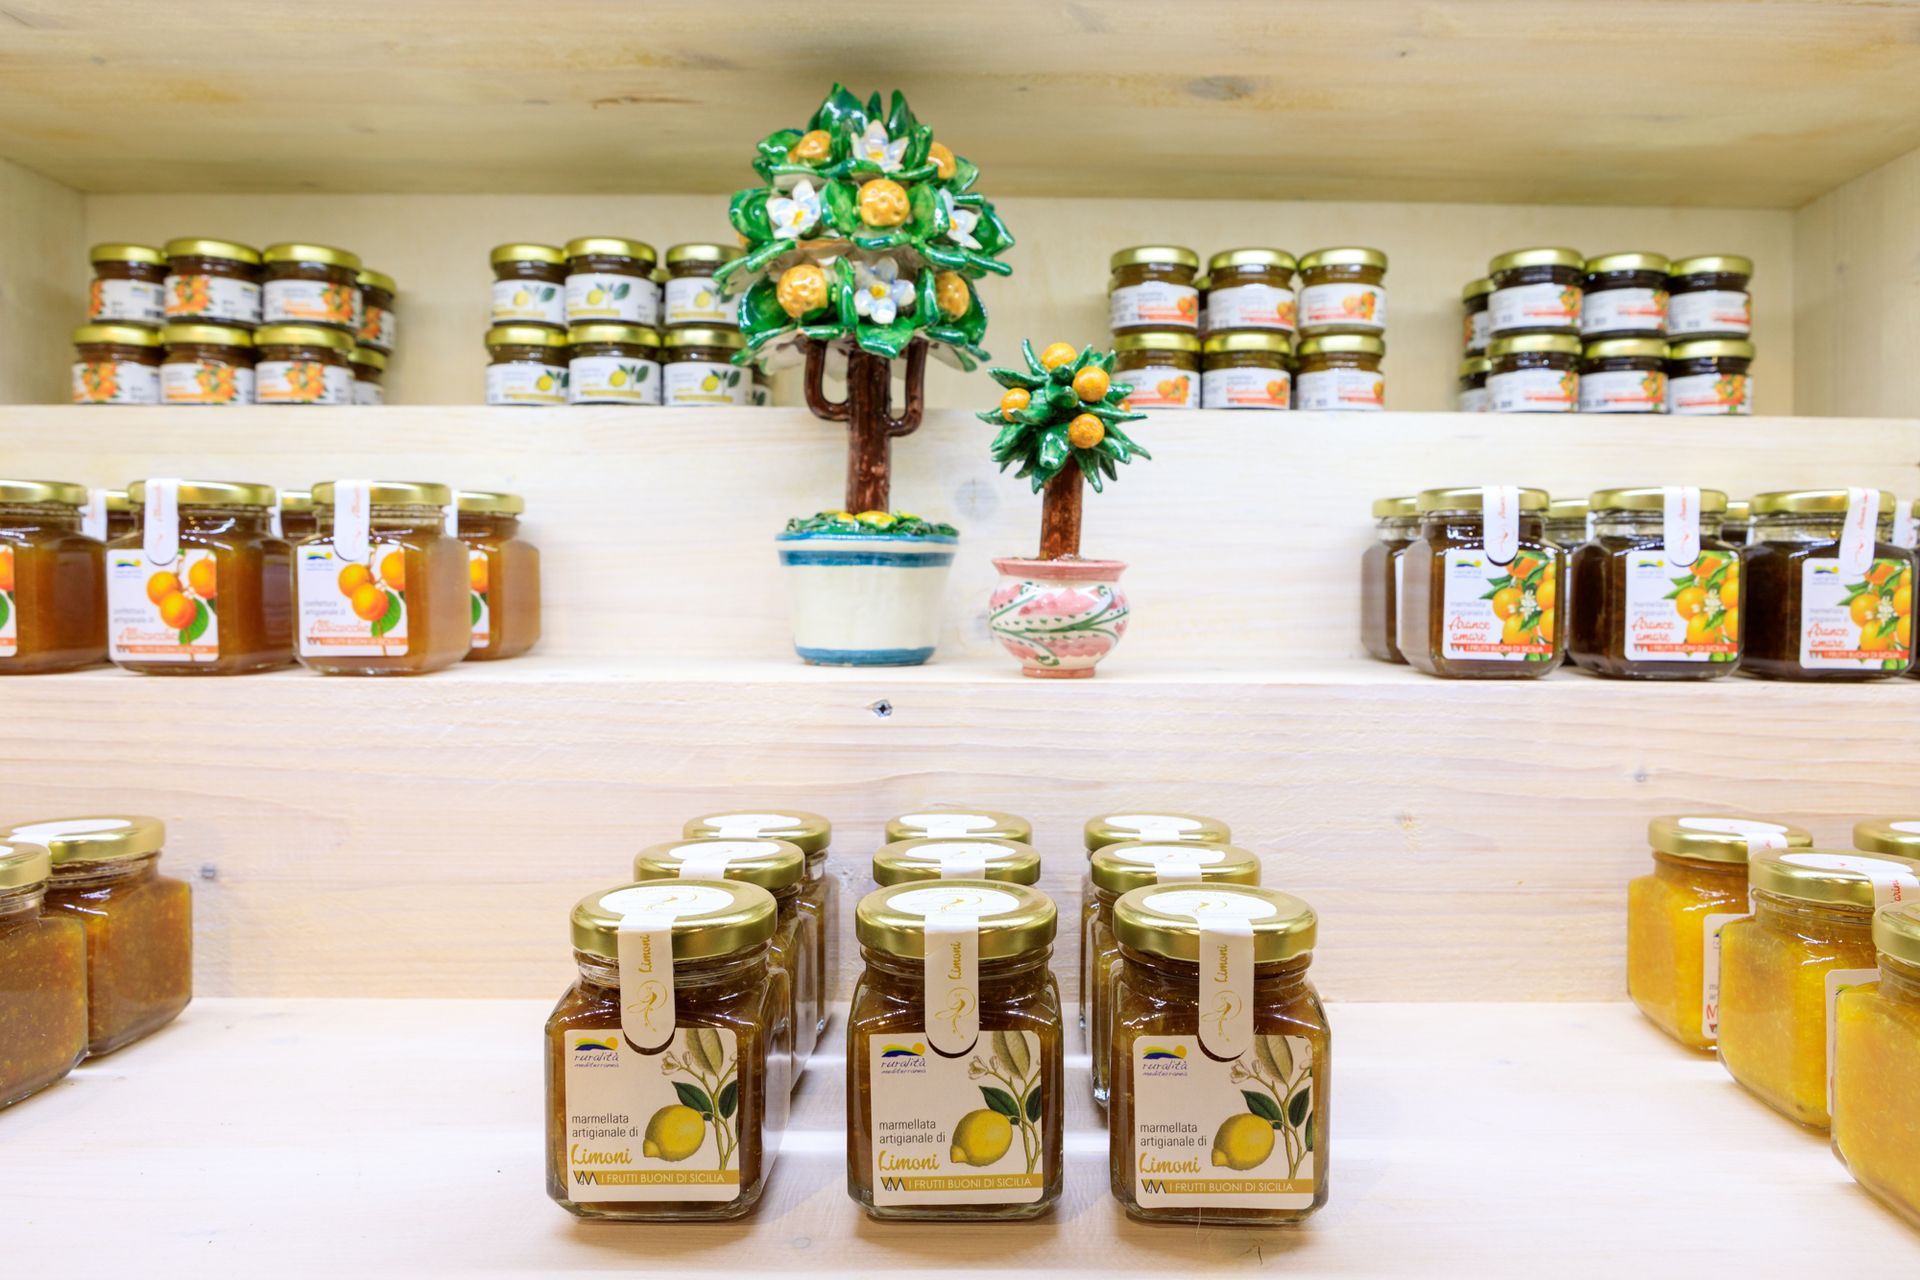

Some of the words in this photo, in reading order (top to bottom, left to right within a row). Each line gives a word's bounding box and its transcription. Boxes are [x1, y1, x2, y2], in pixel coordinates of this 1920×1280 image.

[638, 934, 653, 973] Limoni
[948, 941, 962, 980] Limoni
[1214, 944, 1229, 984] Limoni
[574, 1052, 619, 1062] ruralità
[881, 1057, 926, 1067] ruralità
[1142, 1060, 1188, 1071] ruralità
[572, 1113, 629, 1124] marmellata
[879, 1119, 936, 1130] marmellata
[572, 1127, 626, 1140] artigianale
[629, 1126, 638, 1137] di
[1140, 1122, 1197, 1133] marmellata
[879, 1132, 933, 1145] artigianale
[936, 1132, 945, 1142] di
[1140, 1136, 1194, 1149] artigianale
[1198, 1136, 1207, 1146] di
[571, 1143, 632, 1165] Limoni
[878, 1150, 940, 1171] Limoni
[1139, 1152, 1200, 1174] Limoni
[607, 1174, 638, 1183] FRUTTI
[641, 1174, 674, 1183] BUONI
[677, 1174, 687, 1183] DI
[689, 1174, 724, 1183] SICILIA
[915, 1180, 945, 1188] FRUTTI
[948, 1179, 981, 1188] BUONI
[984, 1179, 994, 1187] DI
[997, 1178, 1032, 1187] SICILIA
[1175, 1183, 1206, 1191] FRUTTI
[1210, 1183, 1242, 1191] BUONI
[1246, 1183, 1256, 1191] DI
[1258, 1182, 1294, 1191] SICILIA
